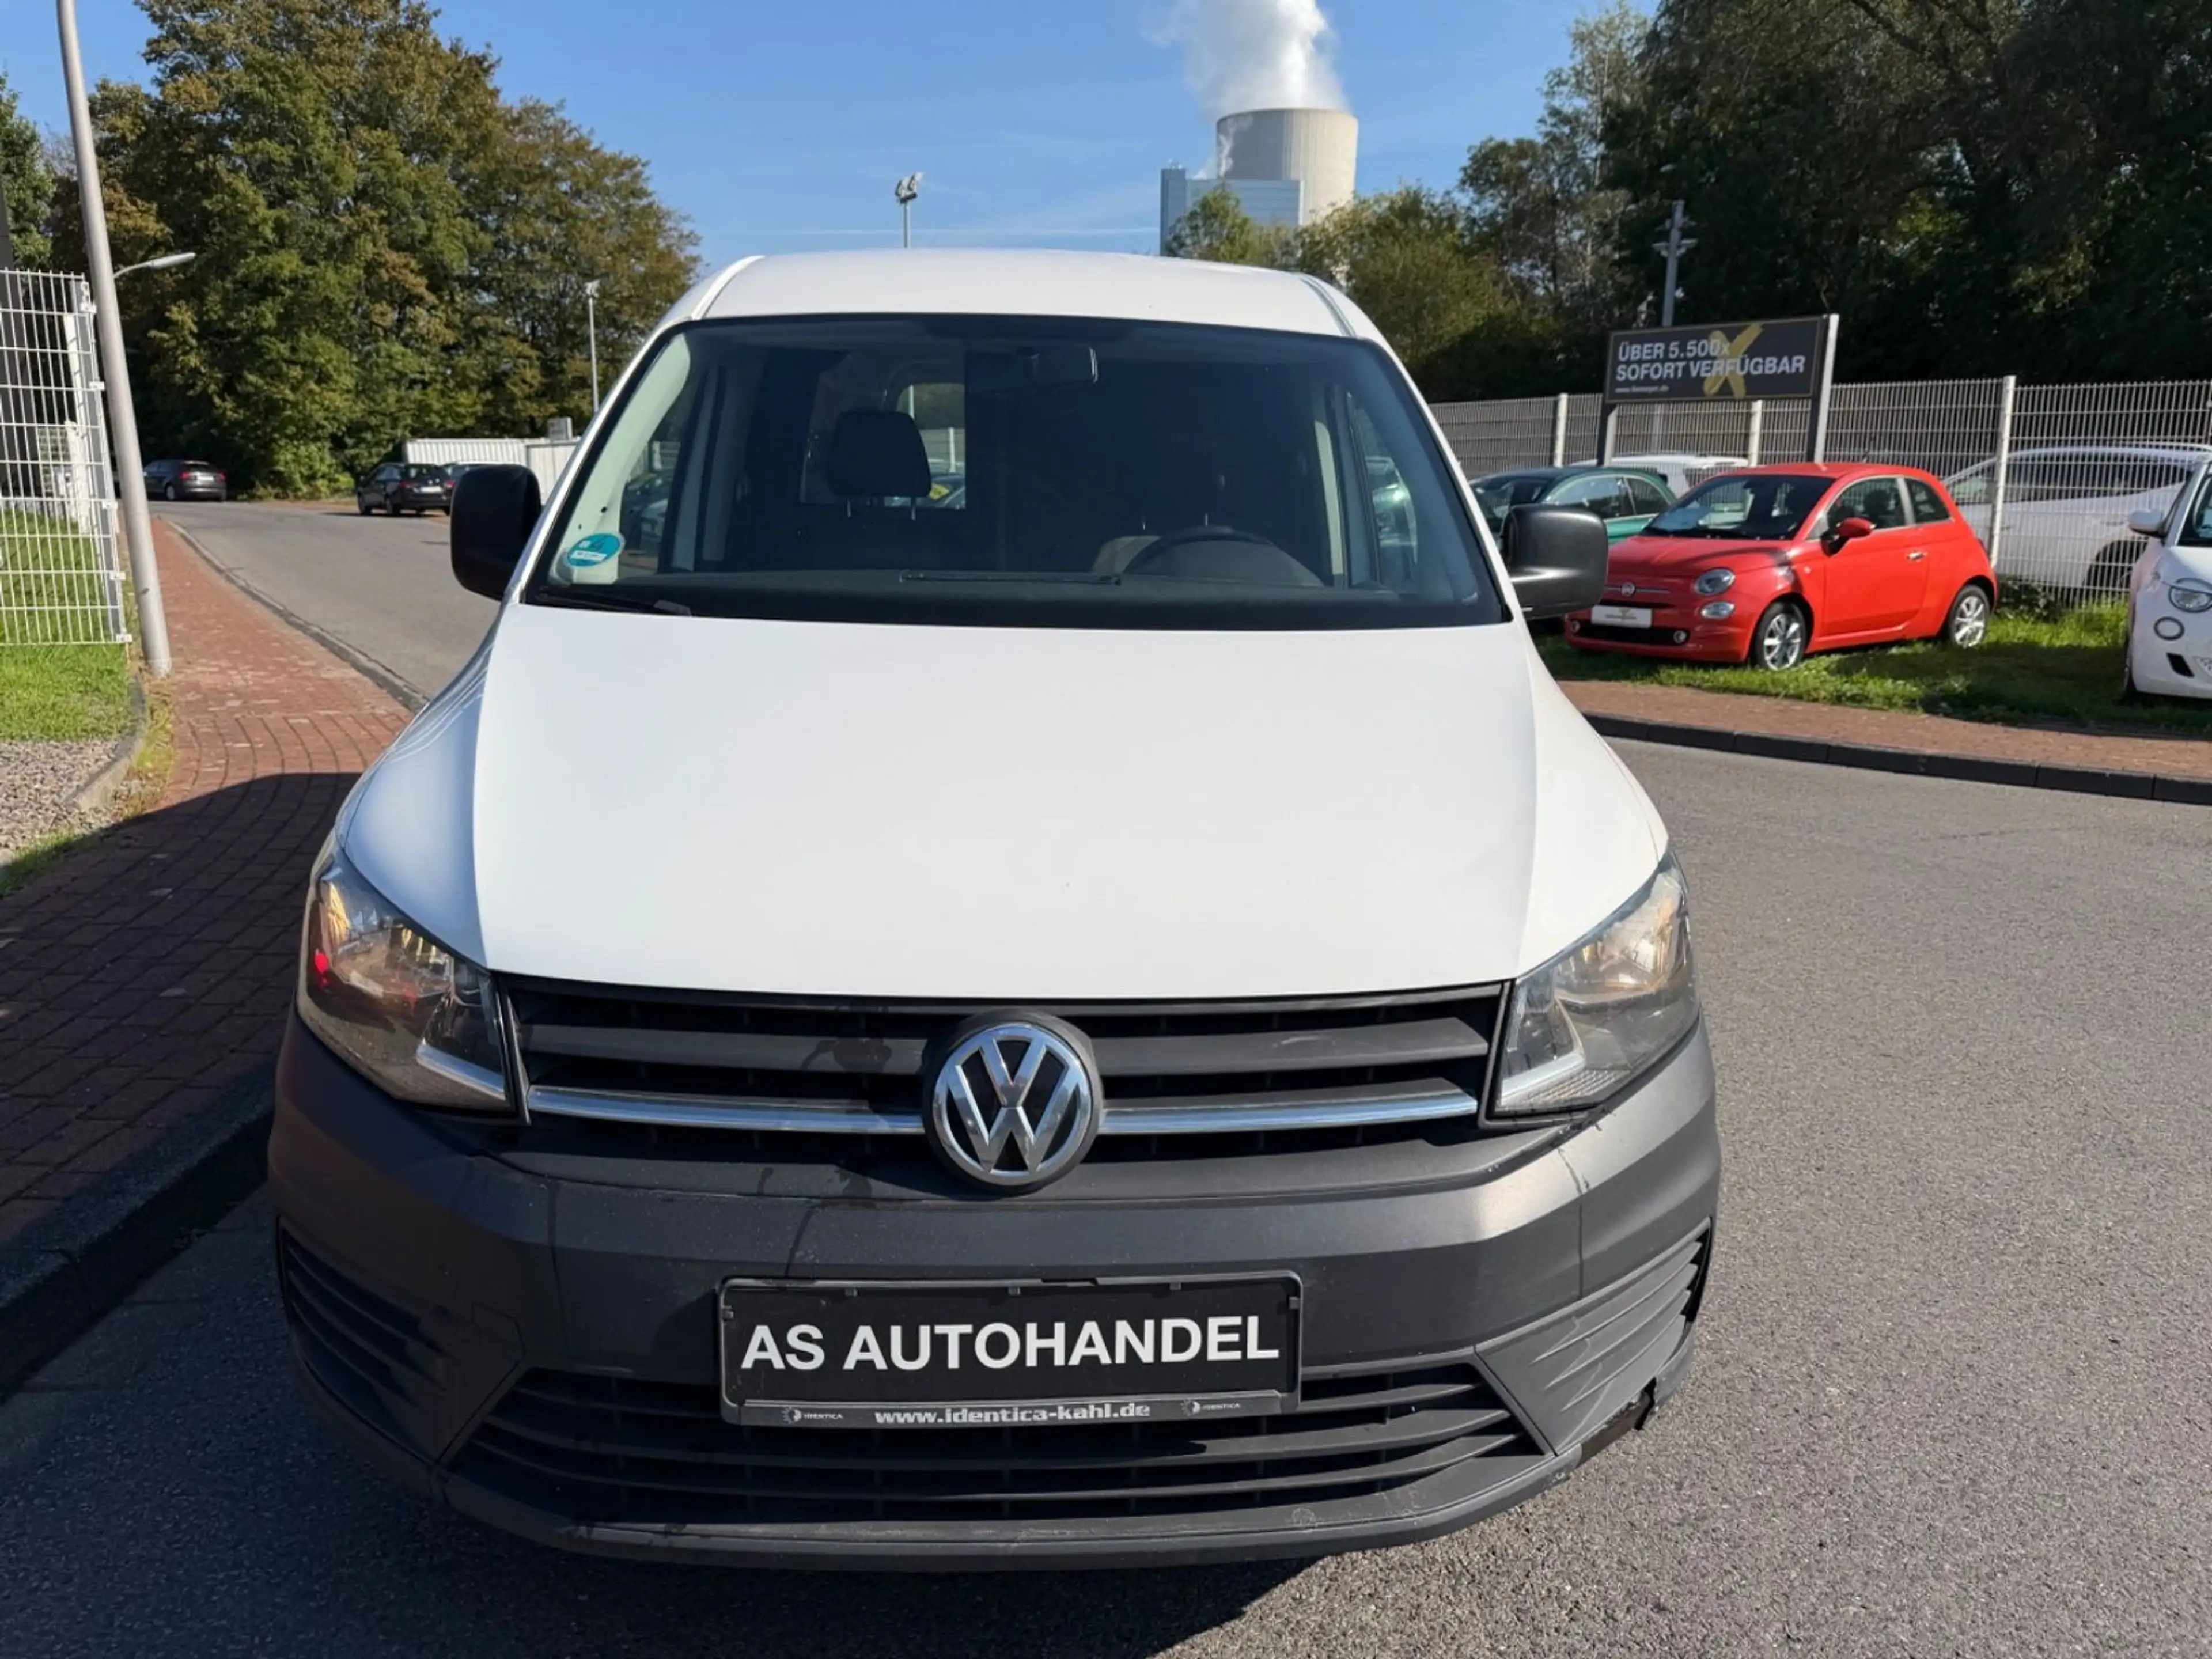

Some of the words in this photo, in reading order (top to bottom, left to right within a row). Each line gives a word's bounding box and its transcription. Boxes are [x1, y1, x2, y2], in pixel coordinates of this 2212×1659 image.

[1618, 341, 1665, 361] ÜBER
[1615, 362, 1687, 381] SOFORT
[1690, 355, 1805, 377] VERFÜGBAR
[741, 1324, 825, 1370] AS
[843, 1315, 1280, 1370] AUTOHANDEL
[875, 1403, 1150, 1423] www.identica-kahl.de
